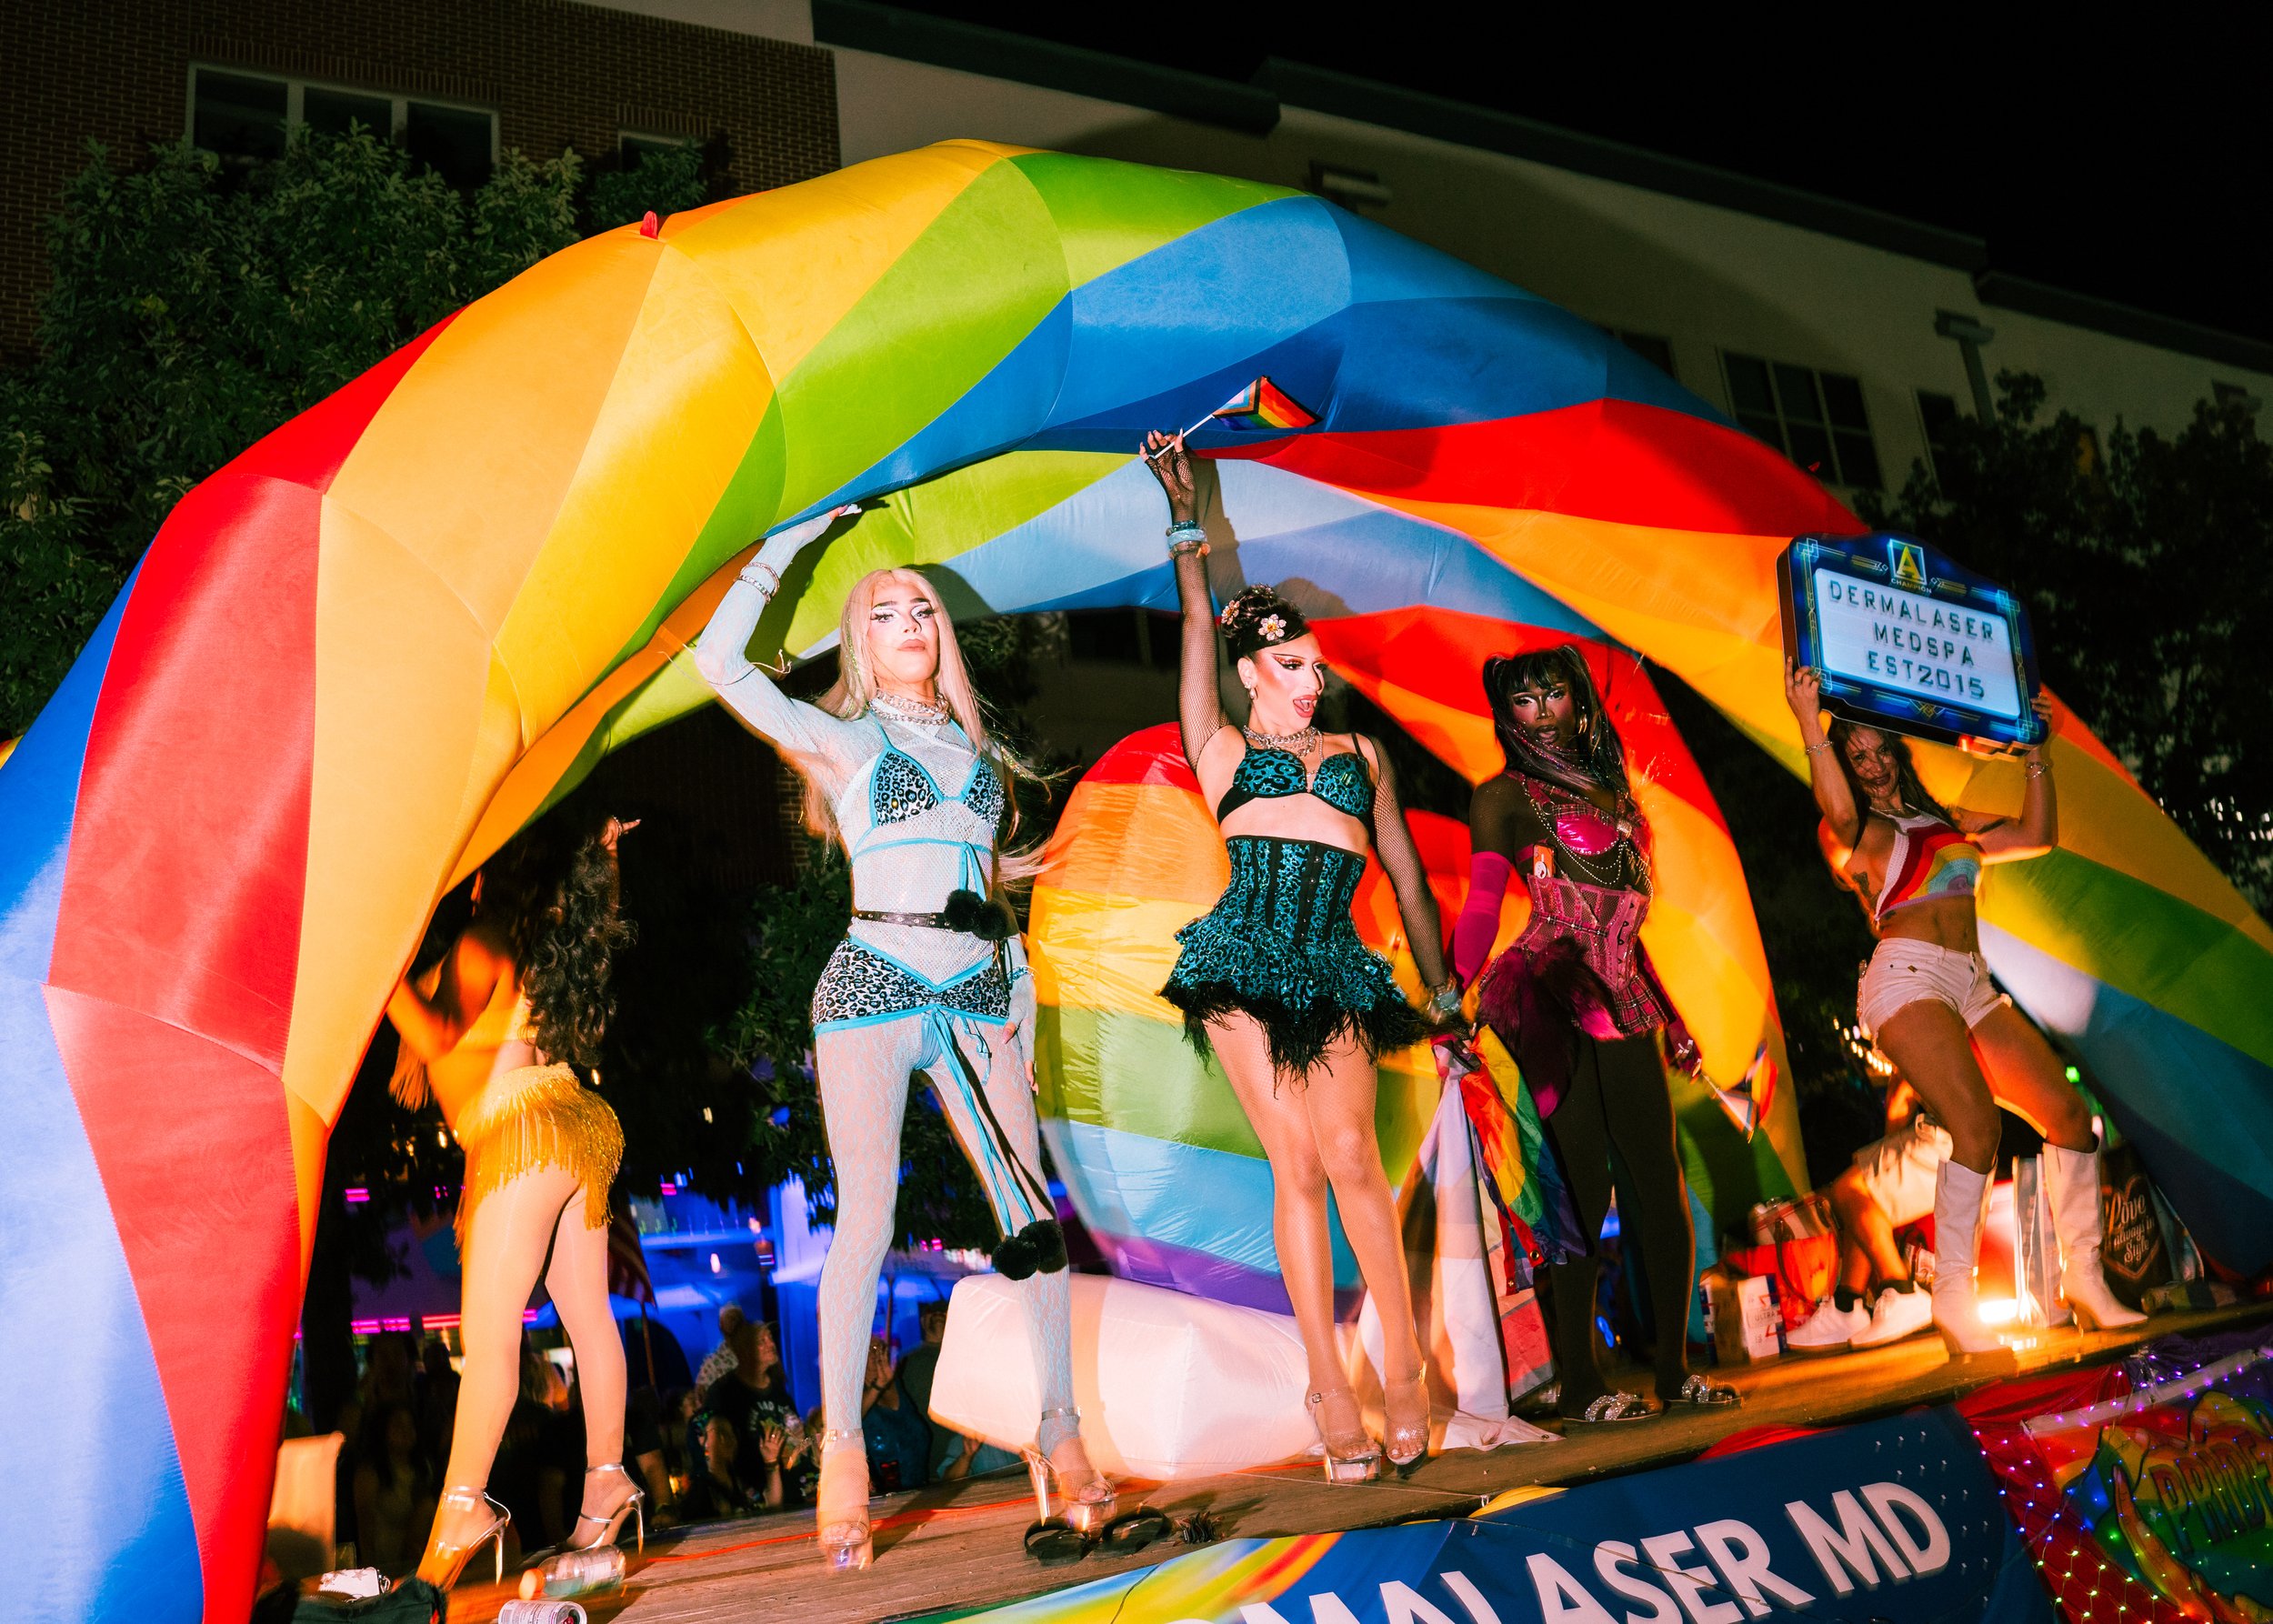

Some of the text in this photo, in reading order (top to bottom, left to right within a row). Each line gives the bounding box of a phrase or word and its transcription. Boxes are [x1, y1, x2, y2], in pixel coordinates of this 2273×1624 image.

[1891, 577, 1932, 594] CHAMPION
[1829, 578, 1994, 641] DERMALASER
[1874, 621, 1975, 667] MEDSPA
[1867, 650, 1986, 699] EST2015
[1755, 1309, 1776, 1321] ULTRA
[1784, 1481, 1951, 1594] MD
